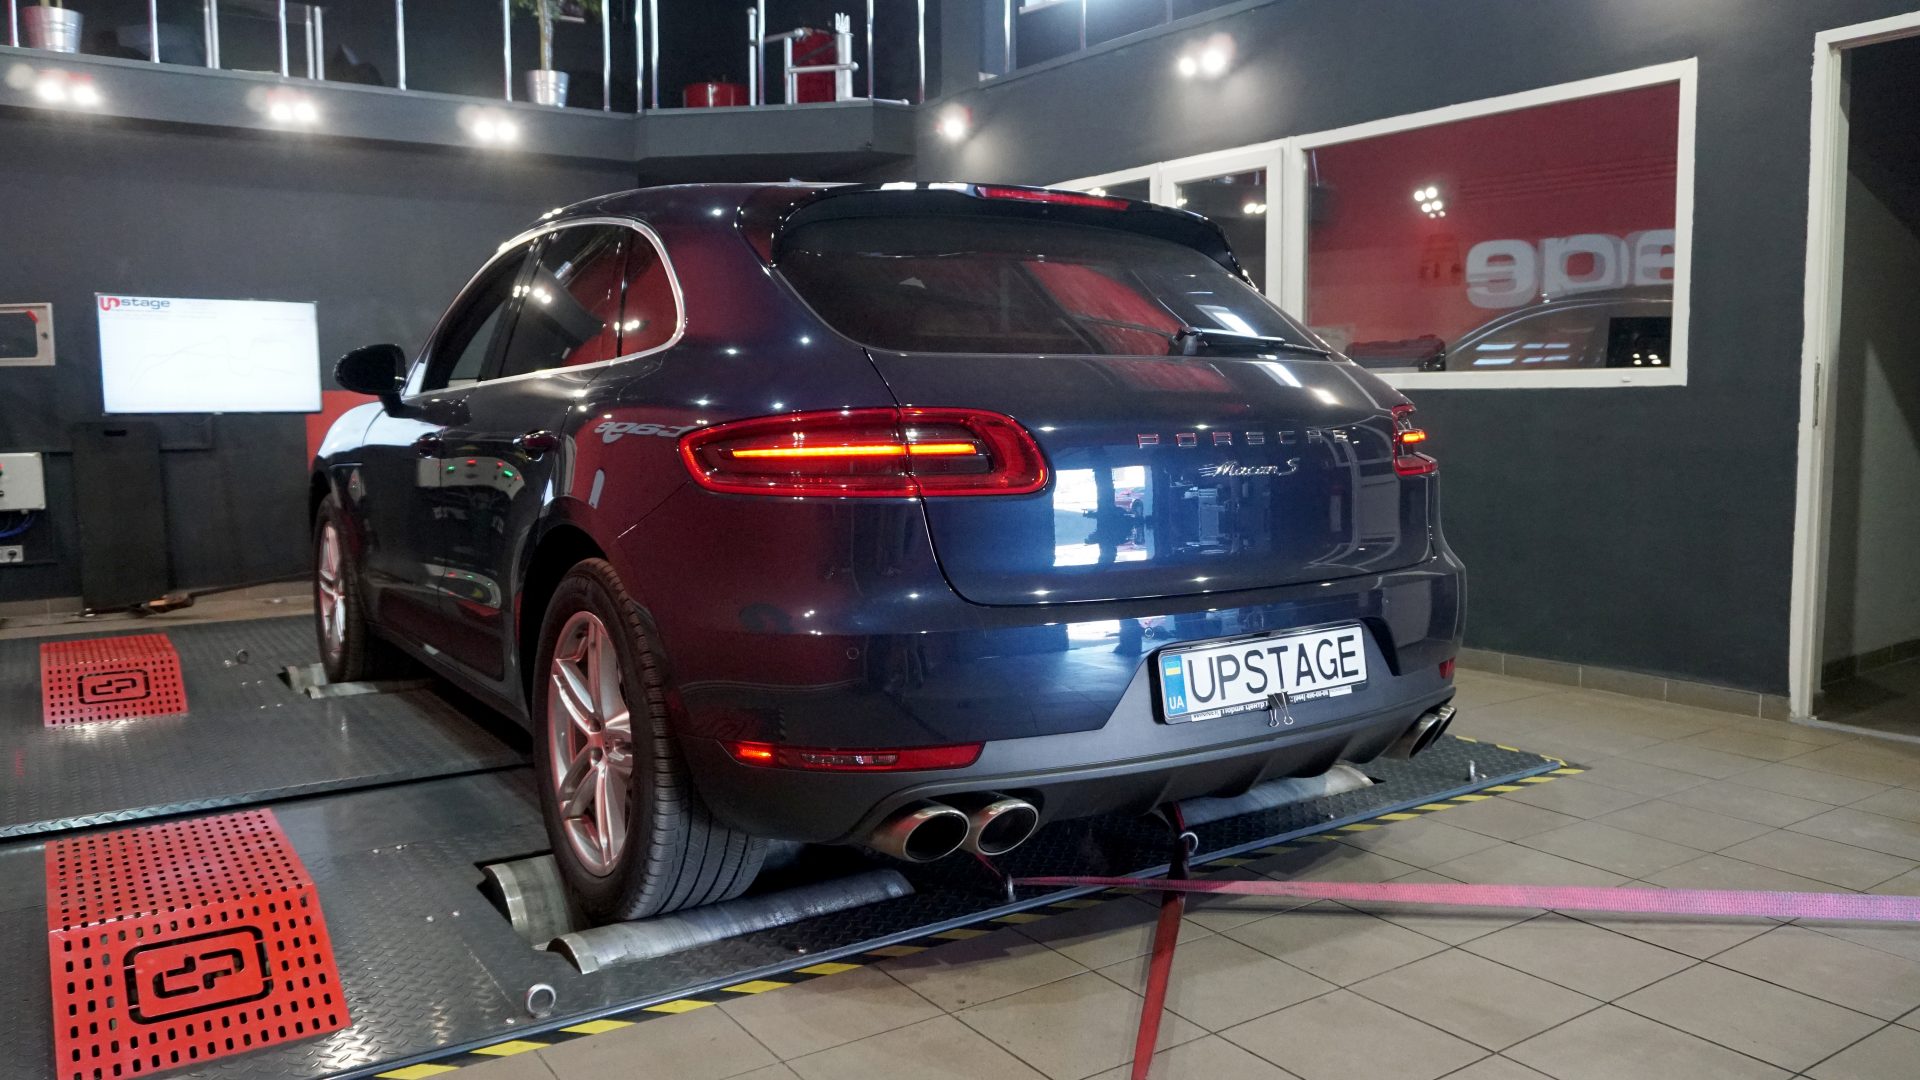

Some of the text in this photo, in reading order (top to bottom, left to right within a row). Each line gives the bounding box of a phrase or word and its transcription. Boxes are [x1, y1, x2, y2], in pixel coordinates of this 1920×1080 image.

[1137, 430, 1349, 448] PORSCHE
[1199, 457, 1300, 477] Macan S
[1188, 635, 1359, 703] UPSTAGE
[1169, 695, 1185, 709] UA
